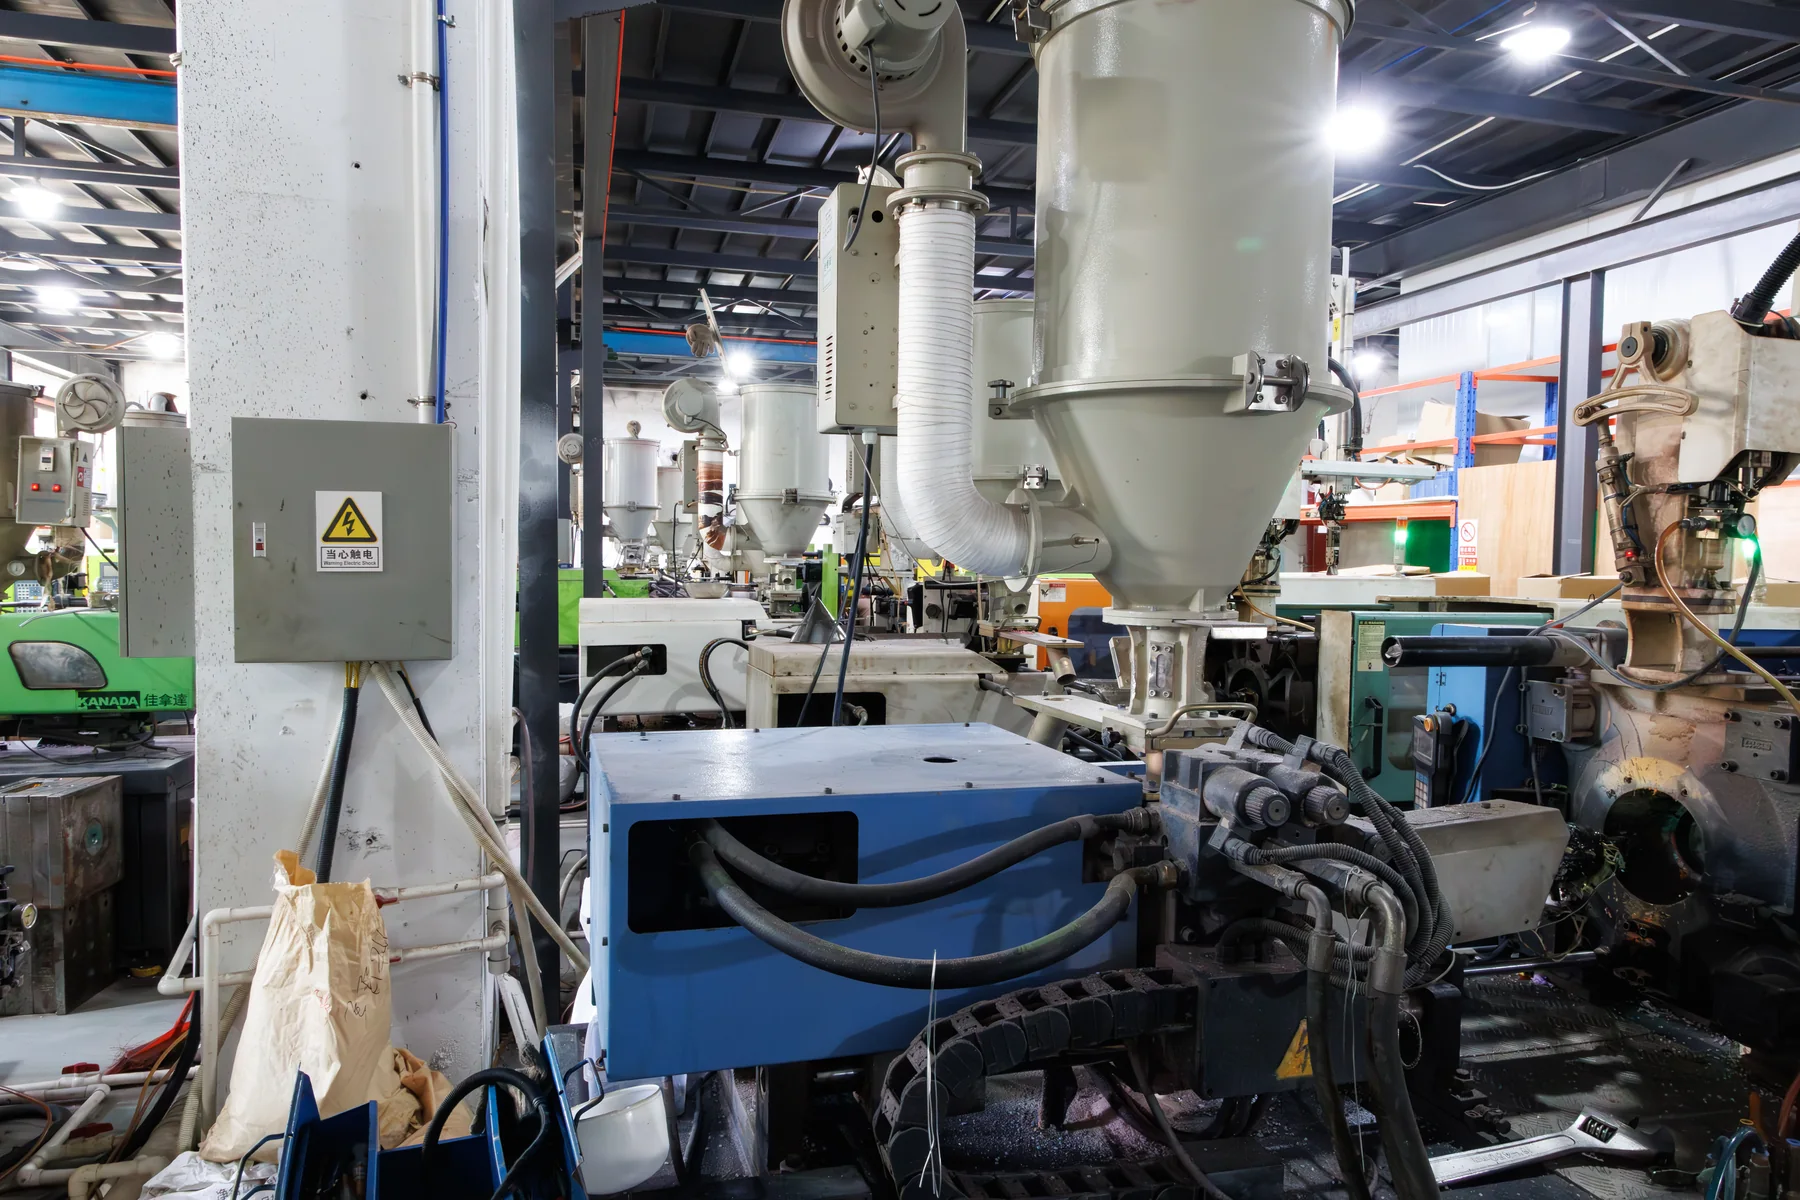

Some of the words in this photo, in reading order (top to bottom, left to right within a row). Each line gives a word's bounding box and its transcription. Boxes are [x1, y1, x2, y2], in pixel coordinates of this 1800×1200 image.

[326, 549, 373, 560] 当心触电
[78, 695, 139, 709] KANADA
[144, 693, 188, 707] 佳拿達
